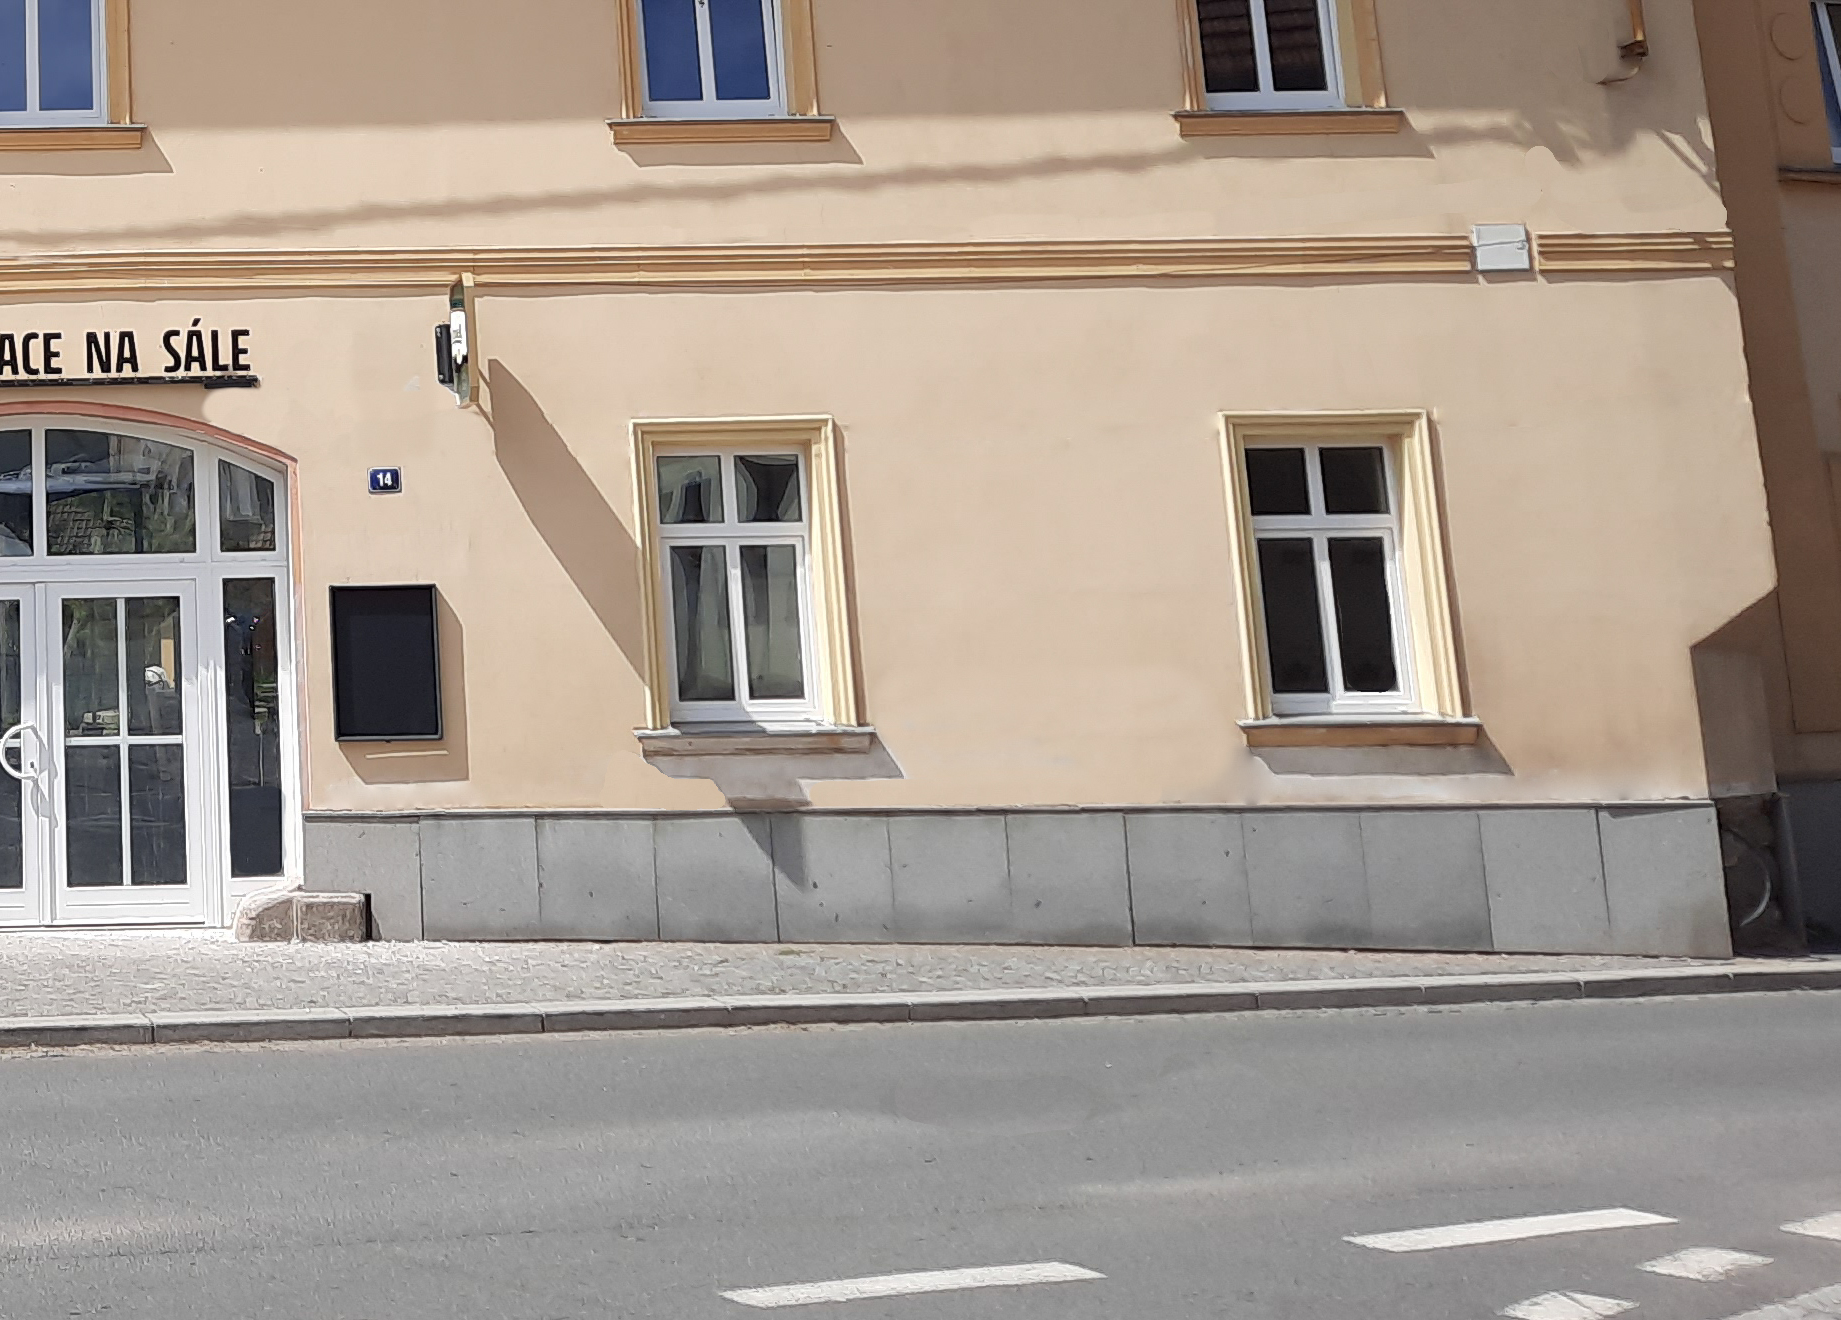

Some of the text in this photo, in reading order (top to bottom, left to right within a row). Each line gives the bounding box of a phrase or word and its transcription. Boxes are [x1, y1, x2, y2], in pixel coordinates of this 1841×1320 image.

[86, 331, 140, 374] NA
[161, 317, 251, 374] SÁLE
[376, 471, 393, 487] 14
